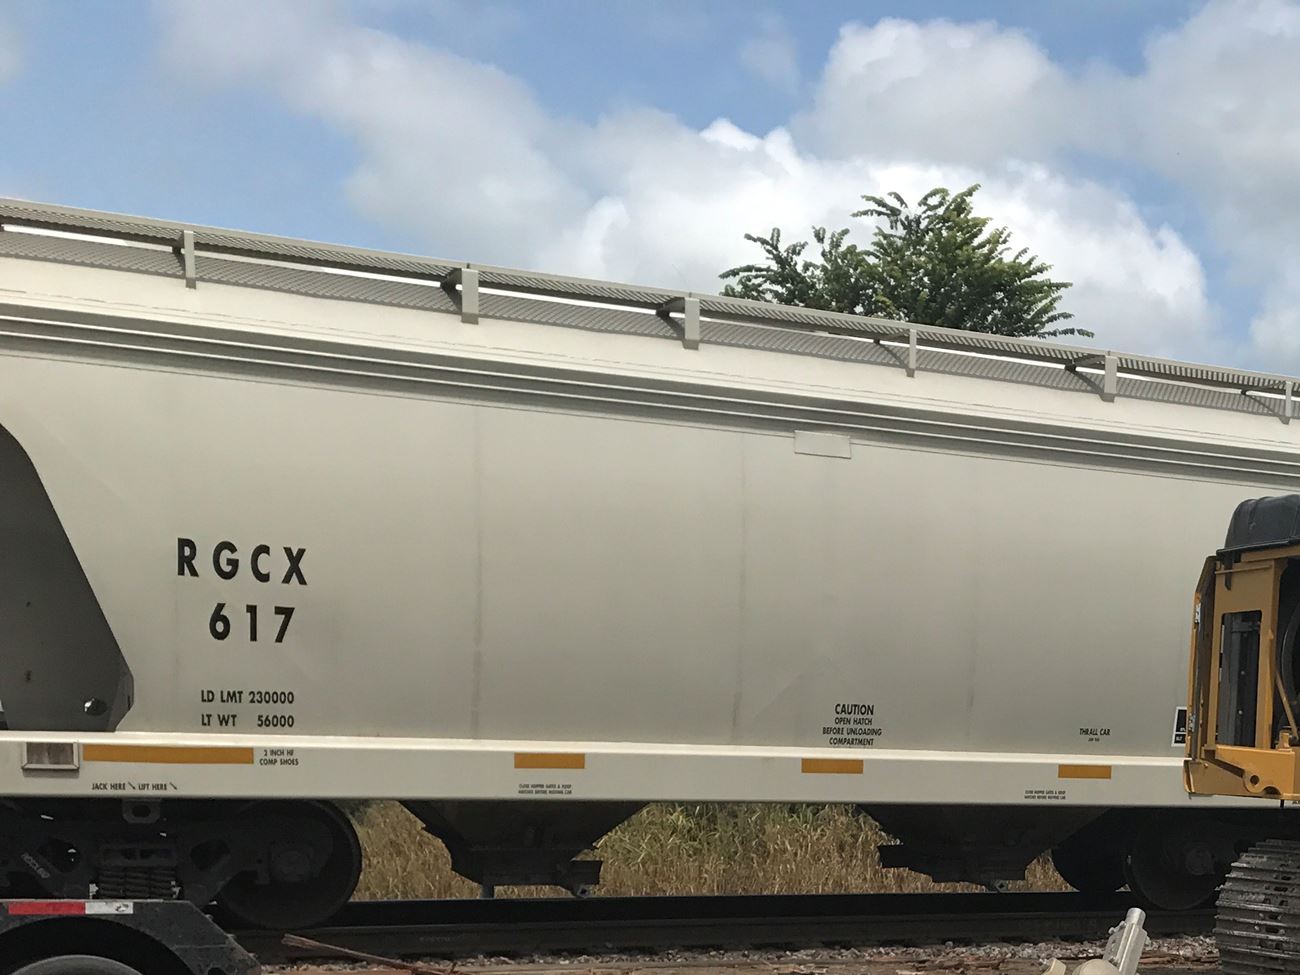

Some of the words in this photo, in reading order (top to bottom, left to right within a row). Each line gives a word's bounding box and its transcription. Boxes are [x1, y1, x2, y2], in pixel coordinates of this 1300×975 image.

[177, 536, 308, 586] RGCX
[208, 602, 296, 643] 617
[200, 689, 215, 703] LD
[220, 690, 244, 704] LMT
[248, 690, 295, 704] 230000
[834, 703, 875, 716] CAUTION
[201, 713, 213, 727] LT
[217, 714, 237, 727] WT
[257, 714, 295, 728] 56000
[834, 716, 852, 725] OPEN
[852, 717, 873, 726] HATCH
[822, 726, 845, 735] BEFORE
[846, 727, 882, 736] UNLOADING
[1099, 728, 1111, 736] CAR
[828, 737, 875, 746] COMPARTMENT
[263, 749, 268, 757] 2
[269, 749, 285, 757] INCH
[259, 758, 278, 766] COMP
[279, 758, 299, 766] SHOES
[91, 782, 108, 791] JACK
[110, 783, 126, 791] HERE
[138, 783, 150, 791] LIFT
[152, 783, 168, 791] HERE
